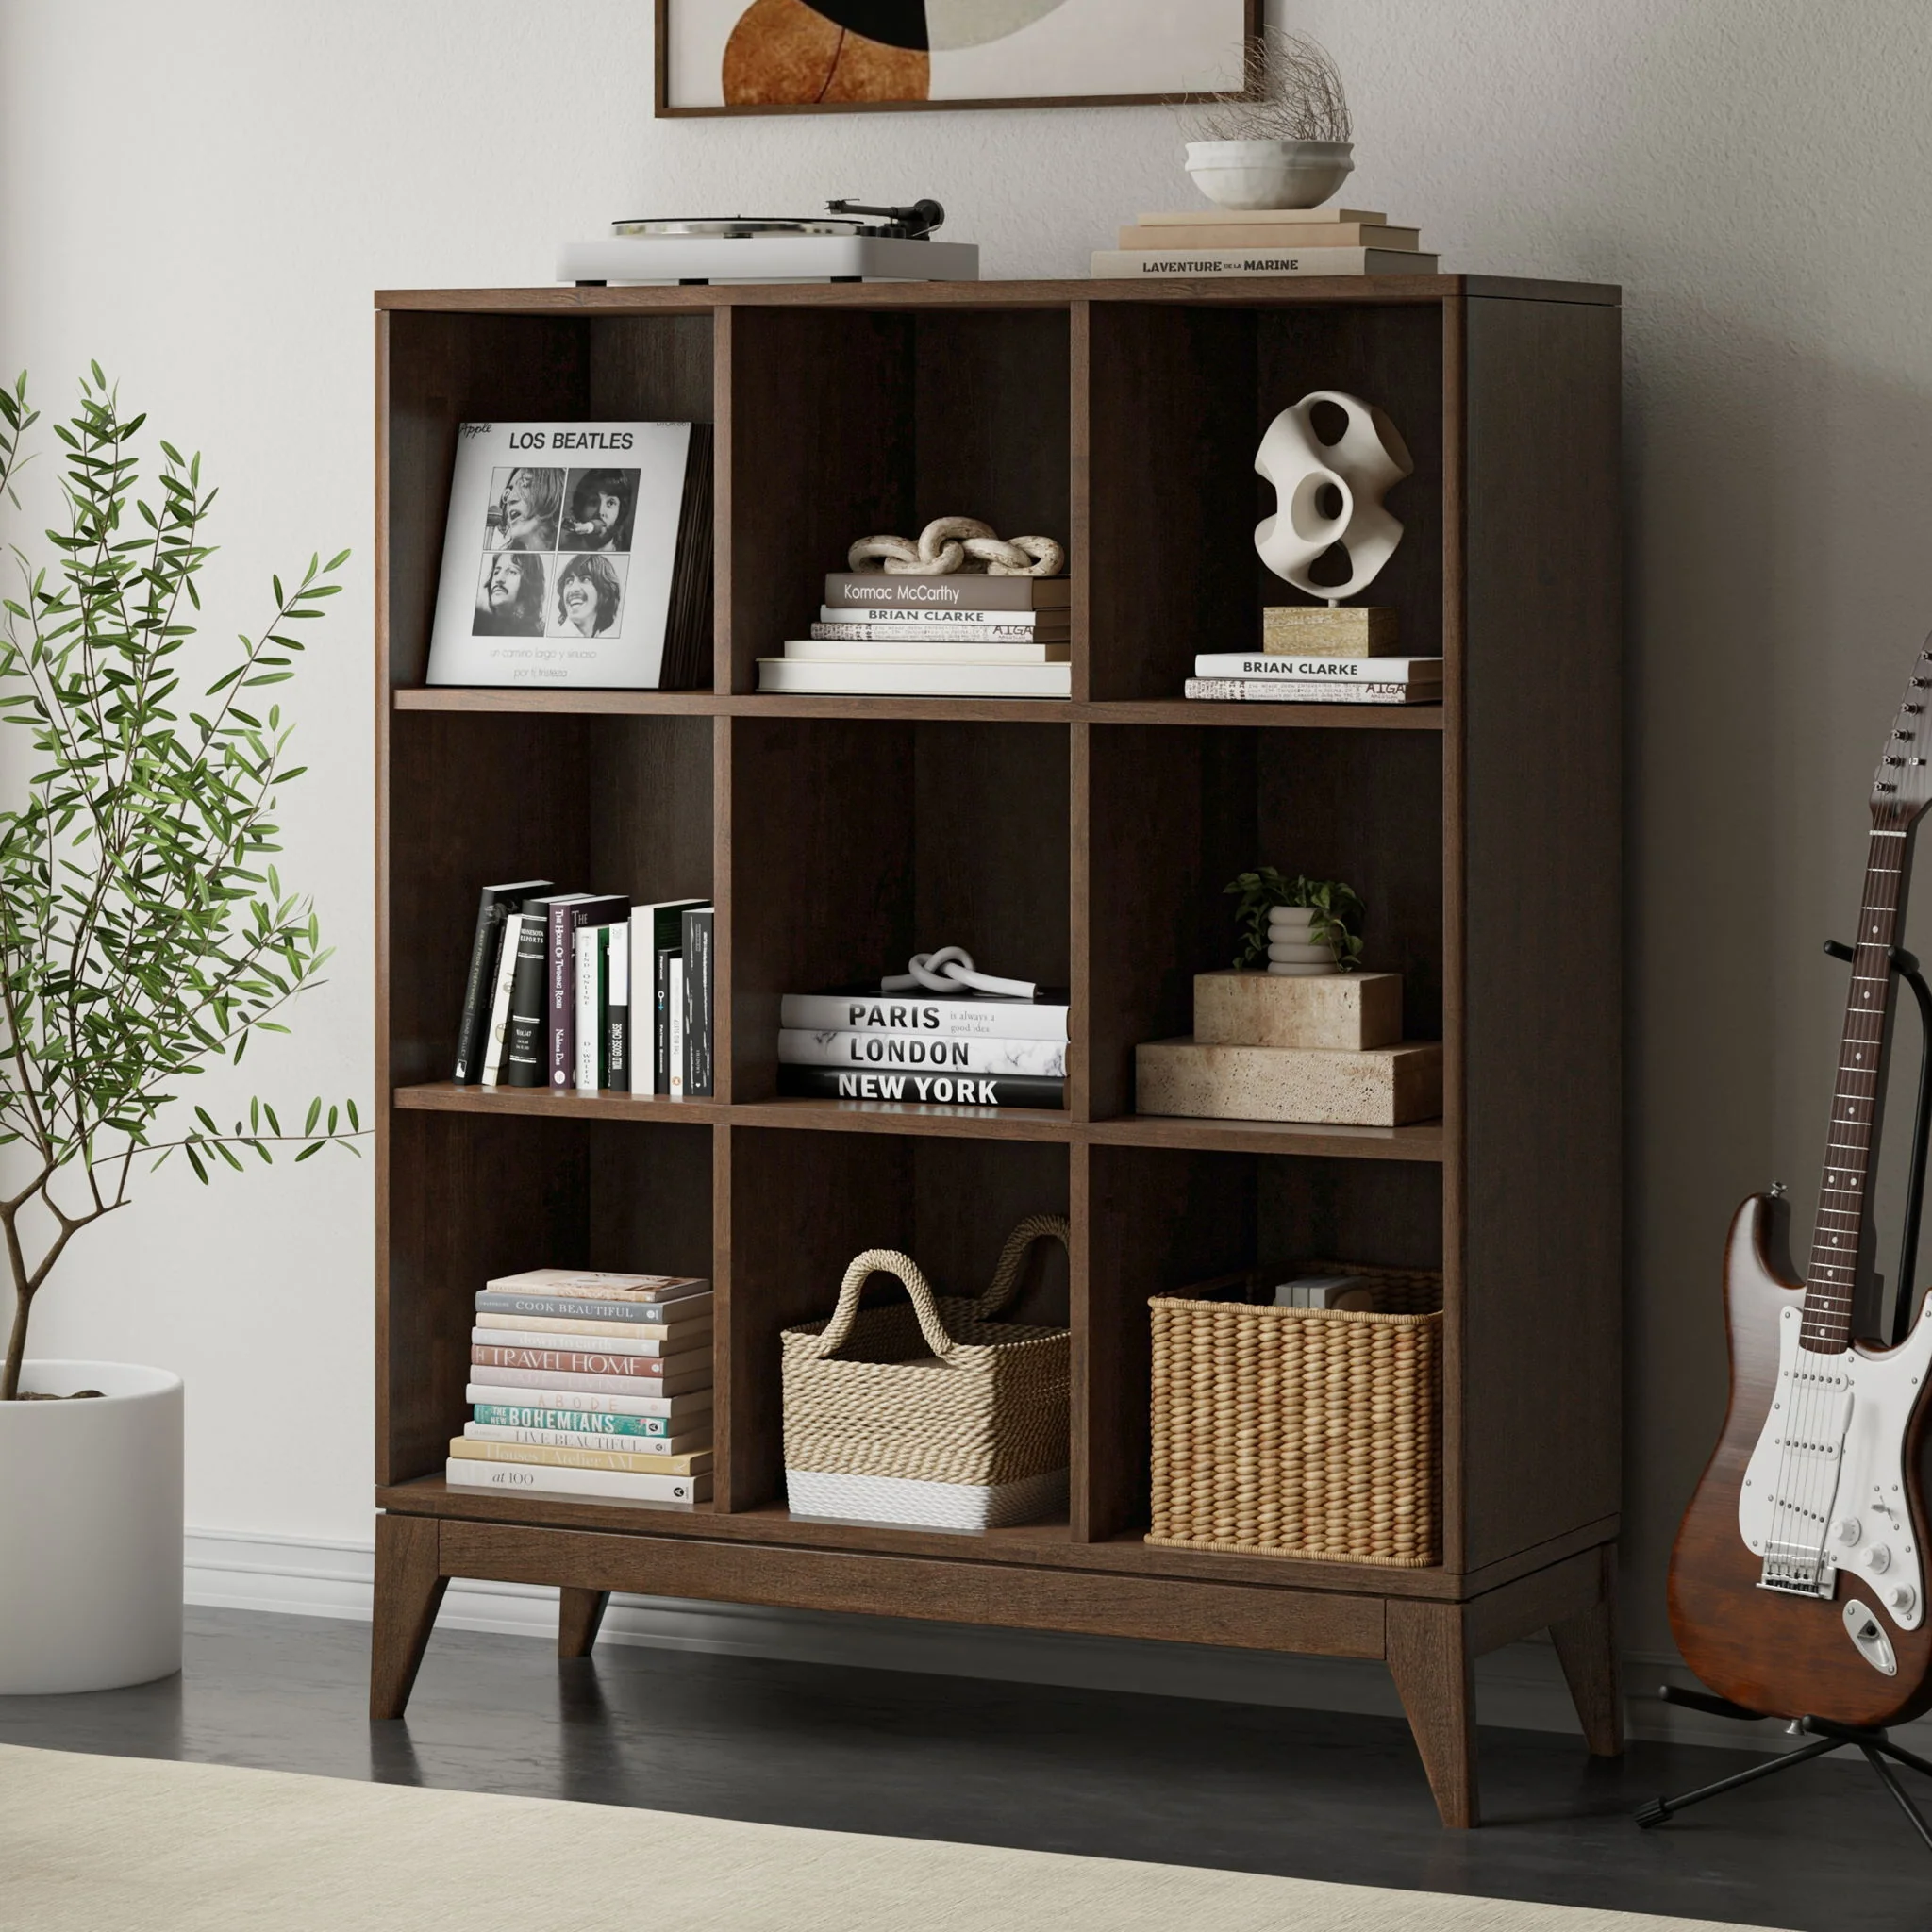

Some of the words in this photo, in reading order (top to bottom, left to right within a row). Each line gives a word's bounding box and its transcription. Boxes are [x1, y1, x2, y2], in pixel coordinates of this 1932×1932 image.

[1142, 261, 1223, 273] LAVENTURE
[1243, 259, 1299, 271] MARINE
[509, 432, 545, 450] LOS
[552, 432, 633, 450] BEATLES
[844, 584, 892, 600] Kormac
[897, 584, 960, 604] McCarthy
[868, 609, 919, 621] BRIAN
[924, 610, 985, 623] CLARKE
[992, 625, 1034, 637] AIGA
[1243, 661, 1293, 674] BRIAN
[1298, 662, 1358, 675] CLARKE
[1365, 683, 1406, 694] AIGA
[849, 1003, 940, 1029] PARIS
[950, 1011, 957, 1020] is
[959, 1010, 988, 1024] always
[611, 1023, 623, 1039] CHASE
[950, 1023, 971, 1034] good
[973, 1024, 990, 1033] idea
[611, 1039, 623, 1057] GOOSE
[850, 1038, 970, 1066] LONDON
[838, 1074, 905, 1100] NEW
[914, 1076, 998, 1105] YORK
[515, 1300, 555, 1313] COOK
[558, 1304, 634, 1319] BEAUTIFUL
[490, 1347, 568, 1371] TRAVEL
[571, 1353, 641, 1376] HOME
[537, 1394, 619, 1412] ABODE
[514, 1430, 557, 1445] LIVE
[558, 1432, 641, 1453] BEAUTIFUL
[491, 1472, 505, 1483] at
[508, 1471, 534, 1486] 100
